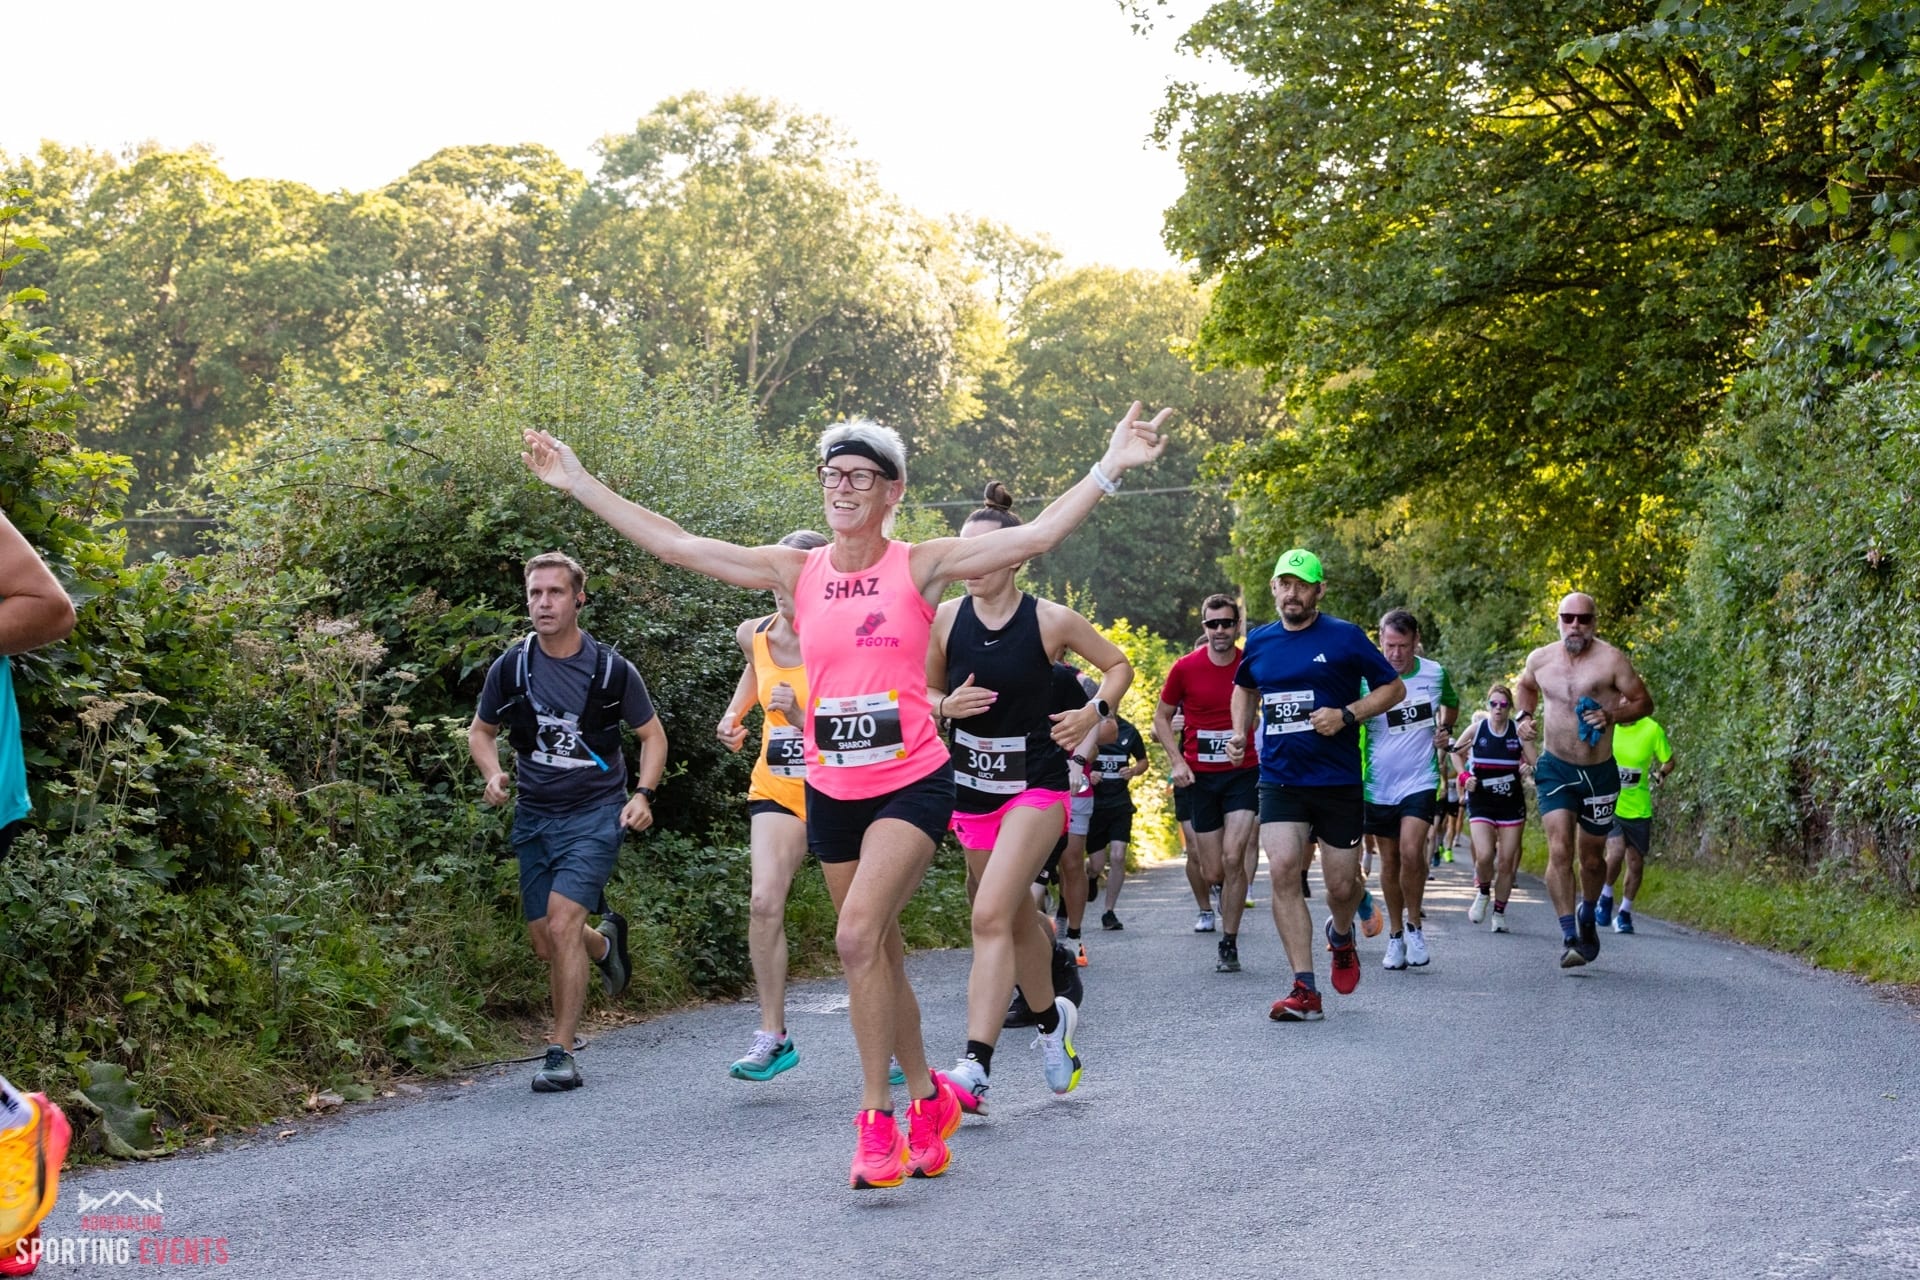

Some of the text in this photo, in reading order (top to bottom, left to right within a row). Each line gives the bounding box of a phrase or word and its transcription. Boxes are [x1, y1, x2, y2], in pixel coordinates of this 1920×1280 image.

[824, 577, 880, 600] SHAZ
[856, 636, 900, 648] #GOTR
[1275, 702, 1301, 719] 582
[1401, 706, 1417, 720] 30
[830, 714, 877, 740] 270
[553, 732, 577, 750] 23
[838, 739, 872, 750] SHARON
[967, 749, 1007, 773] 304
[1101, 761, 1119, 770] 303
[977, 770, 995, 780] LUCY
[1492, 782, 1511, 794] 550
